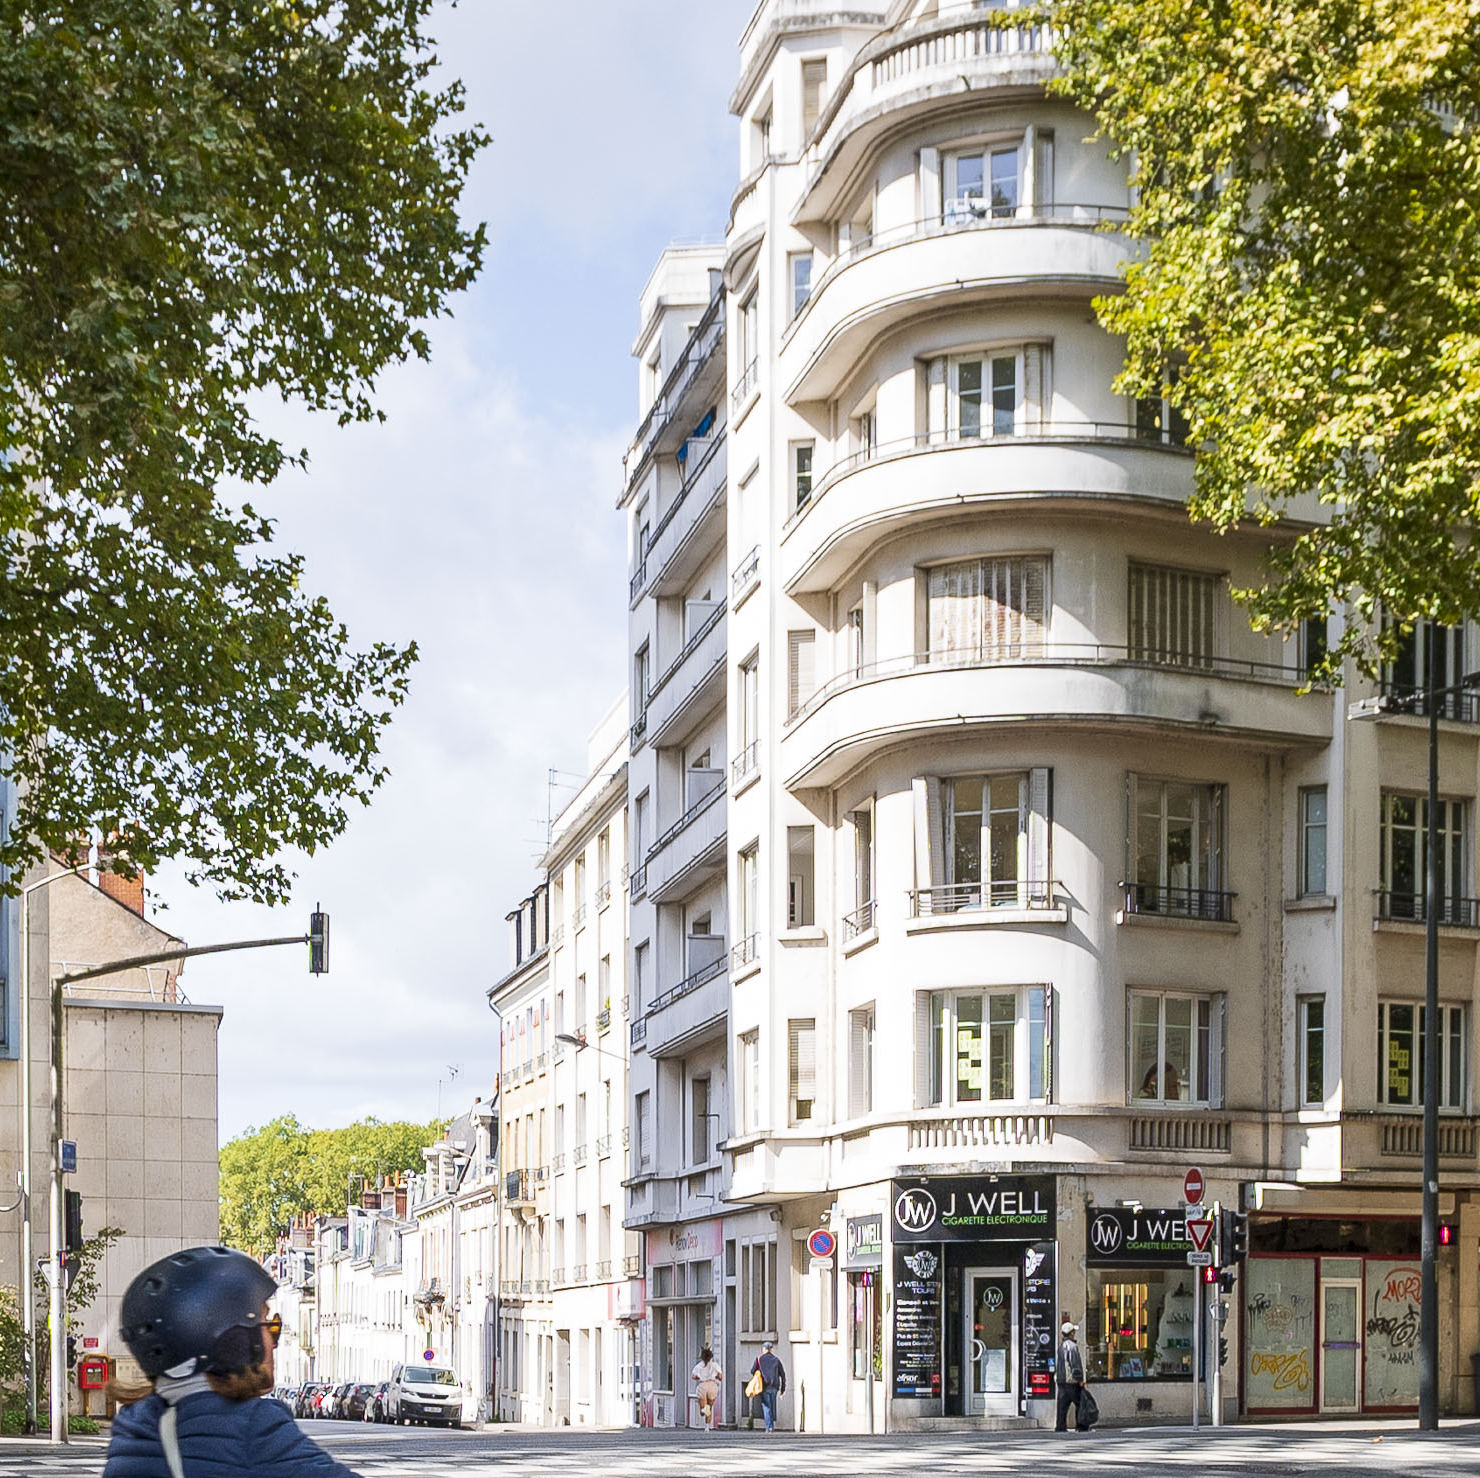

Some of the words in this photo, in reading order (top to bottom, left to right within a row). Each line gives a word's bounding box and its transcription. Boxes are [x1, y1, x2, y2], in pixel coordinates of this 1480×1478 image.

[942, 1192, 956, 1217] J
[967, 1190, 1048, 1216] WELL
[941, 1216, 985, 1226] CIGARETTE
[986, 1214, 1048, 1225] ELECTRONIQUE
[1126, 1219, 1138, 1241] J
[1146, 1219, 1193, 1241] WEL
[1126, 1241, 1160, 1250] CIGARETTE
